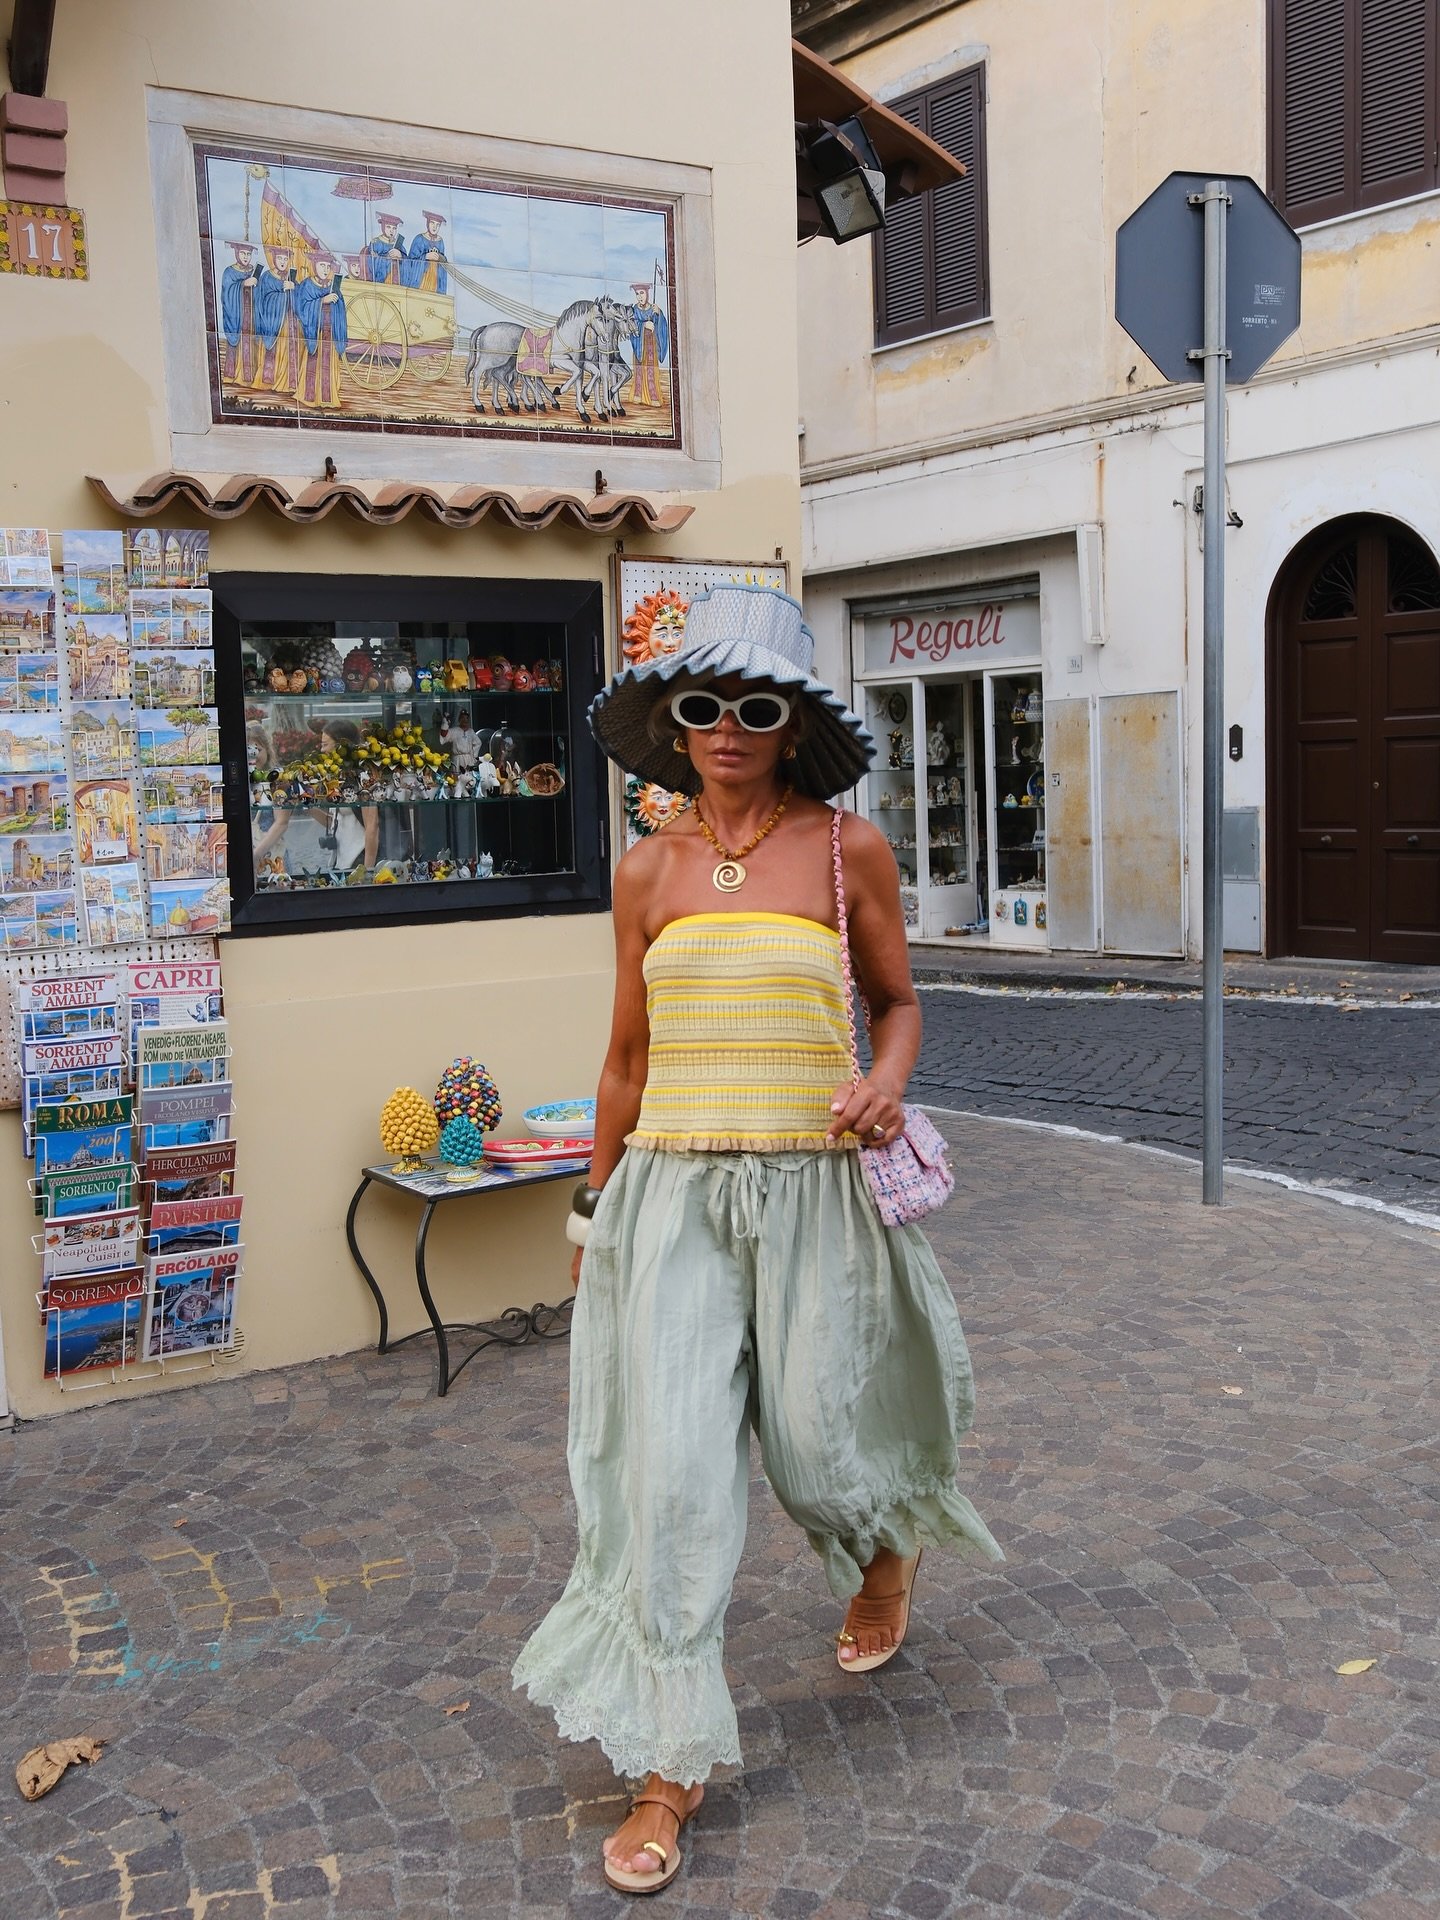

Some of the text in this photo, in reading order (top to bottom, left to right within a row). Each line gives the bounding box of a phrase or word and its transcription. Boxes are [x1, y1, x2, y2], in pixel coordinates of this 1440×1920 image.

[21, 222, 63, 262] 17
[1242, 317, 1267, 325] SORRENTO
[889, 604, 1006, 664] Regali
[31, 980, 106, 997] SORRENT
[134, 969, 214, 990] CAPRI
[45, 992, 98, 1008] AMALFI
[144, 1036, 172, 1050] VENEDIG
[175, 1034, 202, 1048] FLORENZ
[204, 1032, 227, 1045] NEAPEL
[35, 1041, 114, 1060] SORRENTO
[144, 1045, 227, 1063] ROM UND DIE VATIKANSTADT
[50, 1053, 107, 1070] AMALFI
[57, 1100, 124, 1125] ROMA
[159, 1096, 216, 1112] POMPEI
[154, 1108, 192, 1120] ERCOLANO
[151, 1151, 232, 1171] HERCULANEUM
[176, 1166, 208, 1176] OPLONTIS
[60, 1181, 116, 1199] SORRENTO
[159, 1204, 237, 1227] PAESTUM
[54, 1243, 117, 1258] Neapolitan
[155, 1253, 240, 1277] ERCOLANO
